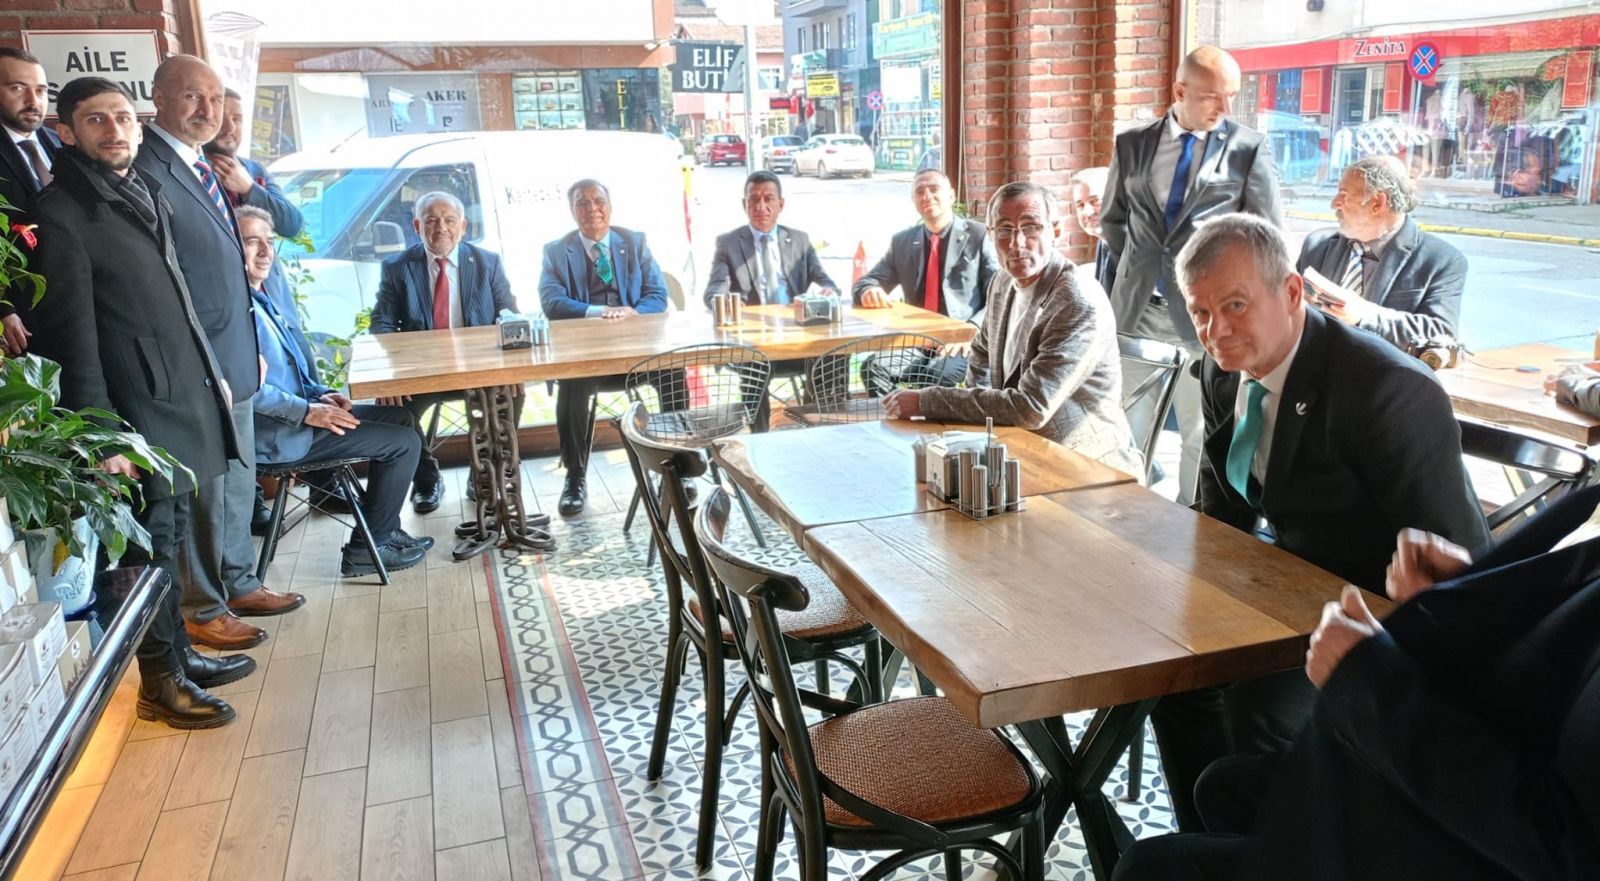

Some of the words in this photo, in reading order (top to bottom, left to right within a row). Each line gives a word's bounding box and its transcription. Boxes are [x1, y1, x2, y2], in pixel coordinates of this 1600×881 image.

[66, 46, 129, 73] AİLE
[47, 80, 154, 103] SNU
[425, 90, 467, 102] AKER
